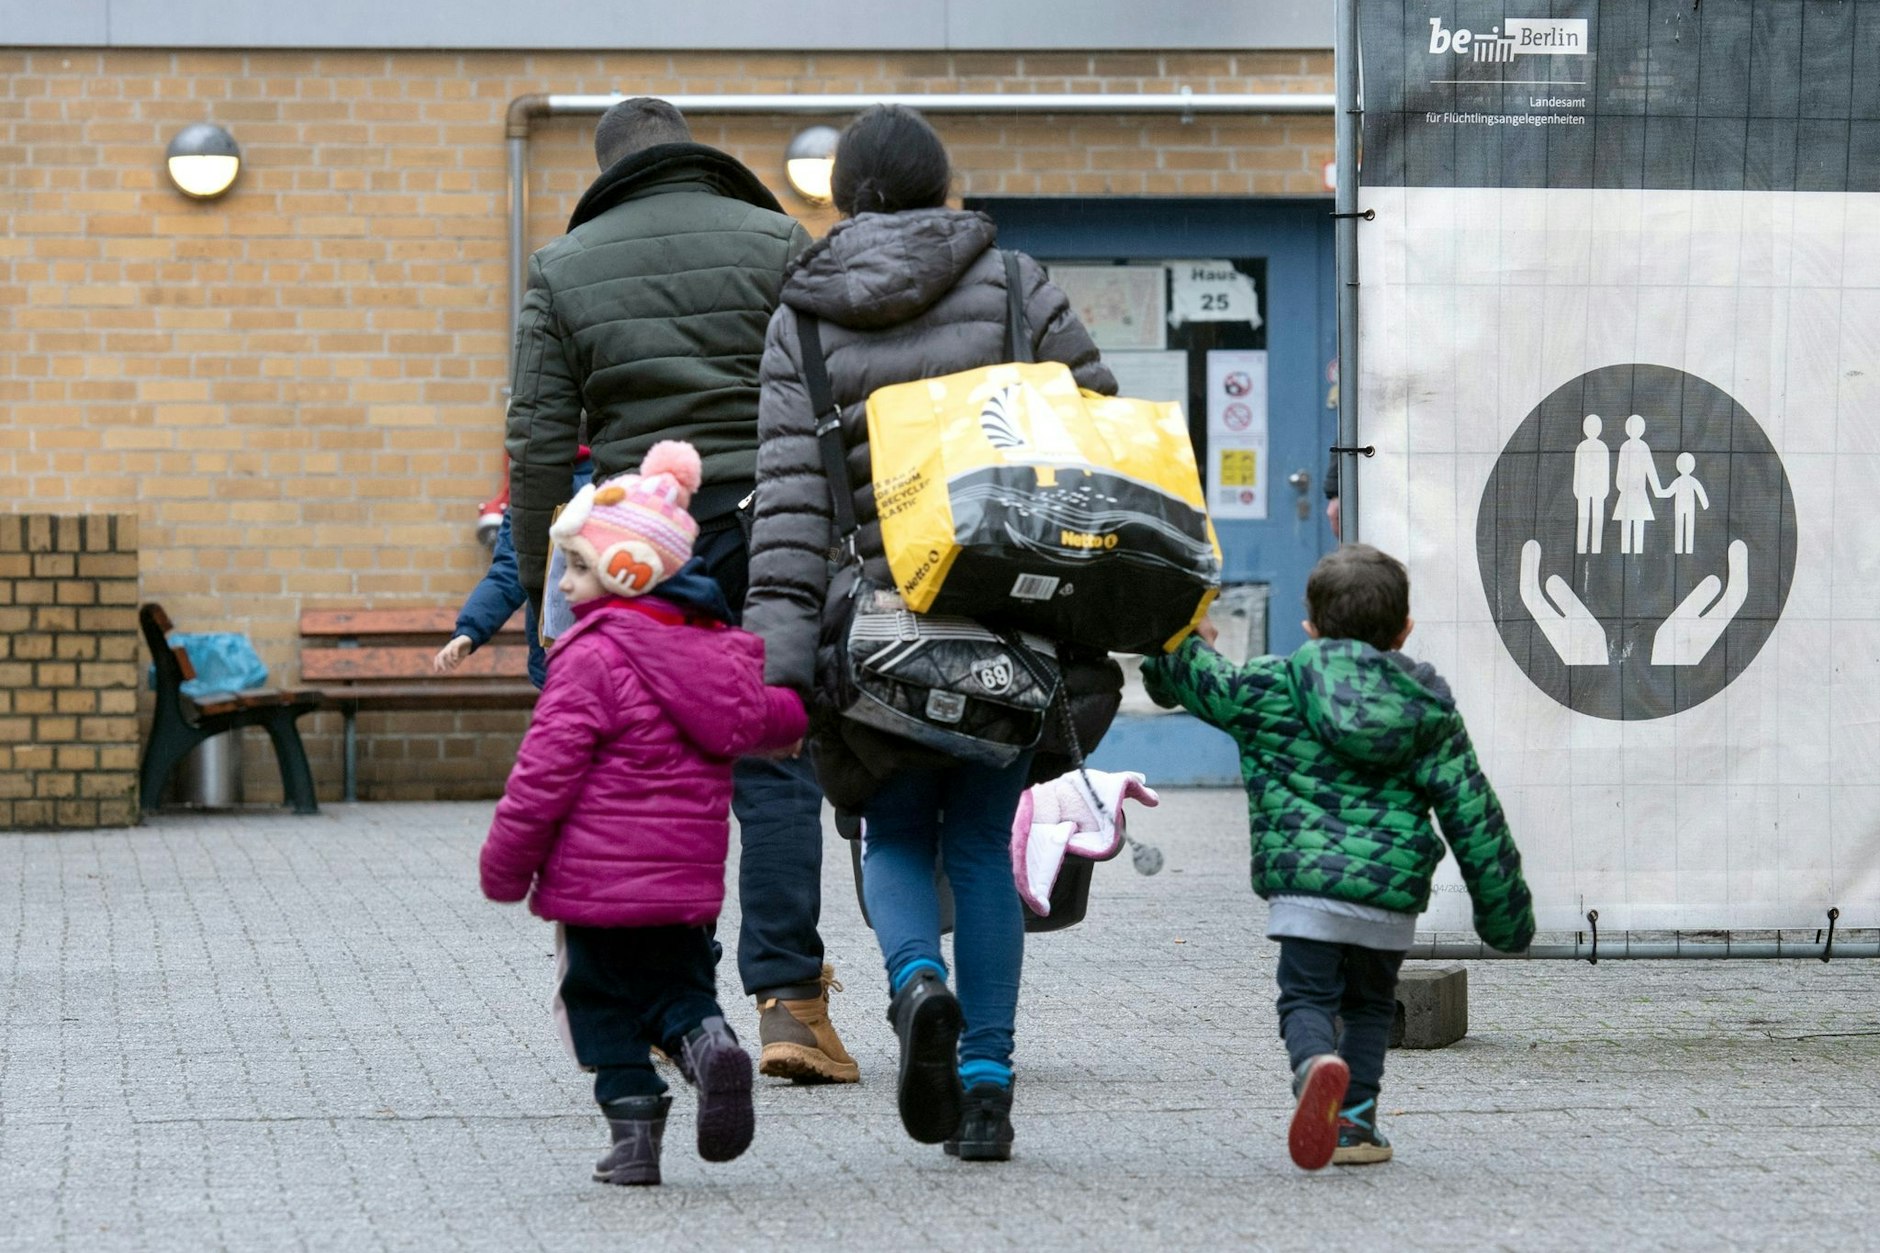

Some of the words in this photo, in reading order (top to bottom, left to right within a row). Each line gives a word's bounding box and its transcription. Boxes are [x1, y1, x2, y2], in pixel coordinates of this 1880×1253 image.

[1429, 17, 1472, 54] be
[1520, 27, 1579, 47] Berlin
[1529, 96, 1586, 108] Landesamt
[1426, 112, 1442, 124] für
[1443, 112, 1586, 127] Flüchtlingsangelegenheiten
[1191, 266, 1238, 281] Haus
[1201, 293, 1230, 312] 25
[881, 497, 919, 520] LASTIC
[1061, 529, 1103, 549] Netto
[903, 562, 931, 594] Netto
[980, 664, 1009, 689] 69
